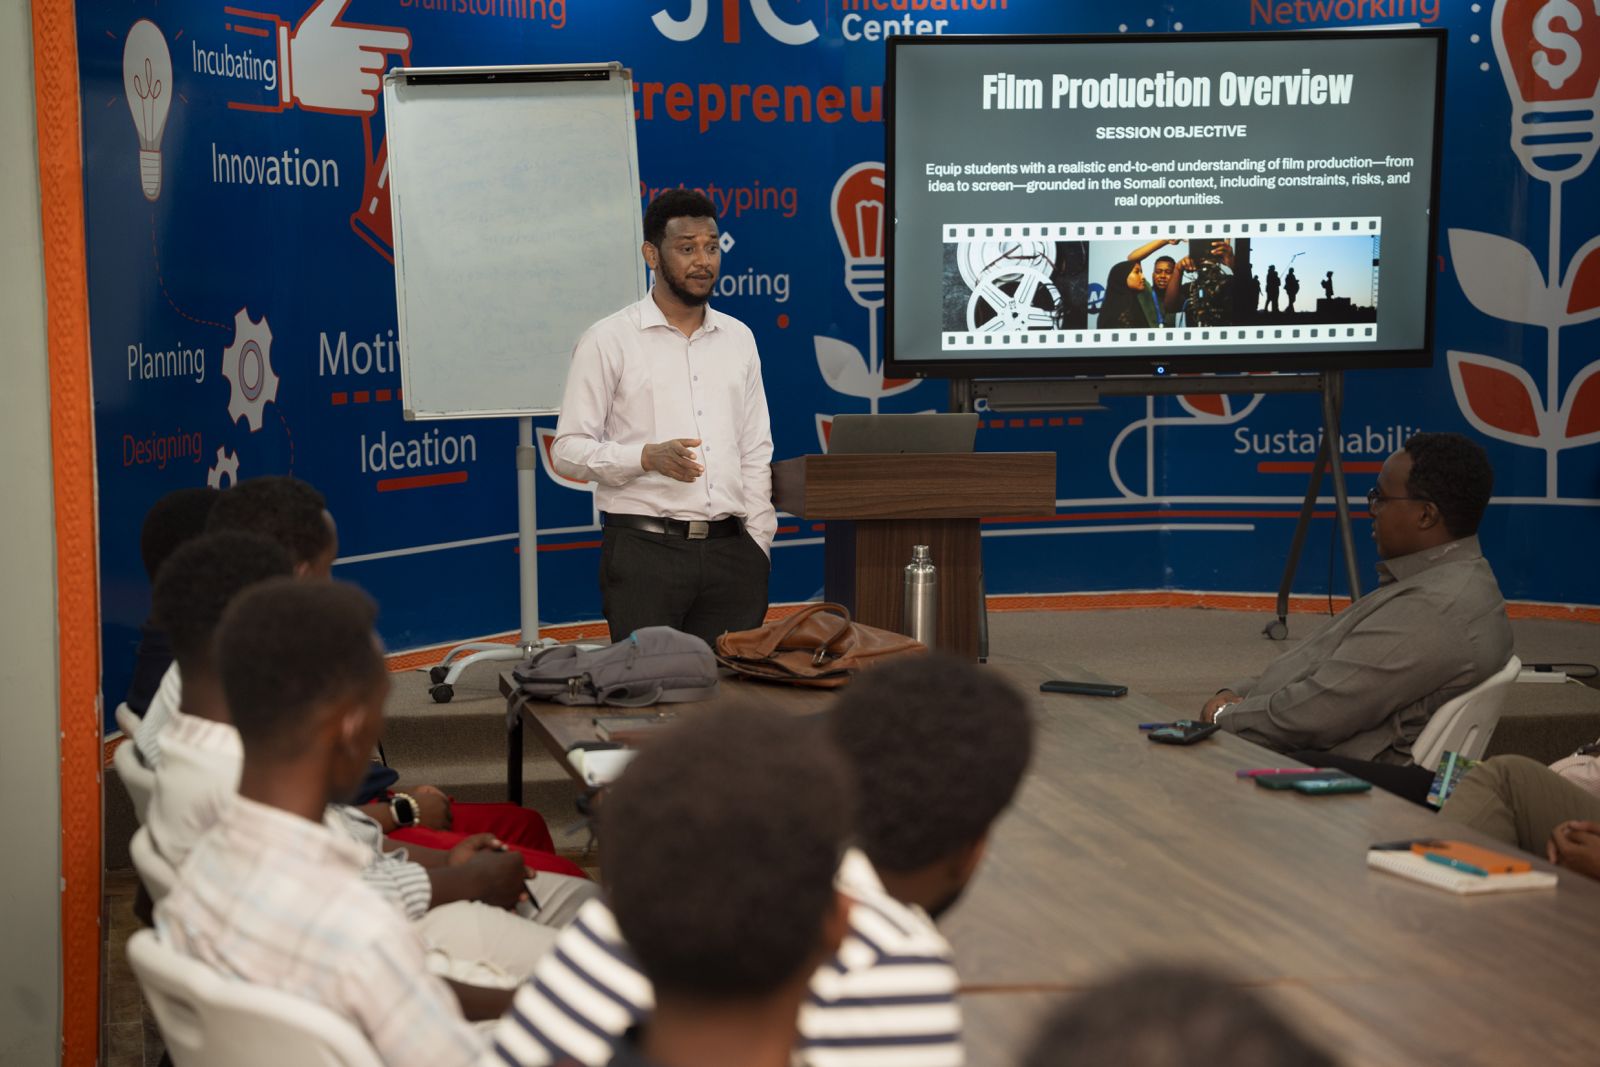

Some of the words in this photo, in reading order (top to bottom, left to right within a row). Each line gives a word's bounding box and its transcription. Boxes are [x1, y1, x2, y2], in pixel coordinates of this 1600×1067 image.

[842, 13, 948, 42] Center
[1250, 0, 1440, 26] Networking
[192, 40, 277, 91] Incubating
[633, 82, 886, 134] repreneu
[982, 73, 1044, 110] Film
[1051, 70, 1211, 110] Production
[1218, 68, 1354, 107] Overview
[1095, 126, 1162, 140] SESSION
[1163, 124, 1247, 139] OBJECTIVE
[211, 143, 340, 188] Innovation
[925, 163, 962, 177] Equip
[964, 162, 1018, 175] students
[1020, 161, 1044, 174] with
[1047, 164, 1056, 174] a
[1058, 161, 1106, 174] realistic
[1107, 160, 1176, 173] end-to-end
[1177, 158, 1266, 172] understanding
[1268, 158, 1281, 170] of
[1282, 157, 1305, 170] film
[928, 179, 955, 192] idea
[956, 180, 970, 191] to
[1087, 178, 1100, 190] in
[1101, 178, 1122, 190] the
[1123, 177, 1166, 189] Somali
[1167, 176, 1218, 189] context,
[1219, 174, 1276, 189] including
[1277, 173, 1350, 187] constraints,
[1351, 172, 1385, 186] risks,
[1386, 172, 1411, 184] and
[1114, 194, 1138, 207] real
[1139, 193, 1224, 209] opportunities.
[127, 343, 206, 384] Planning
[122, 430, 202, 470] Designing
[360, 428, 477, 473] Ideation
